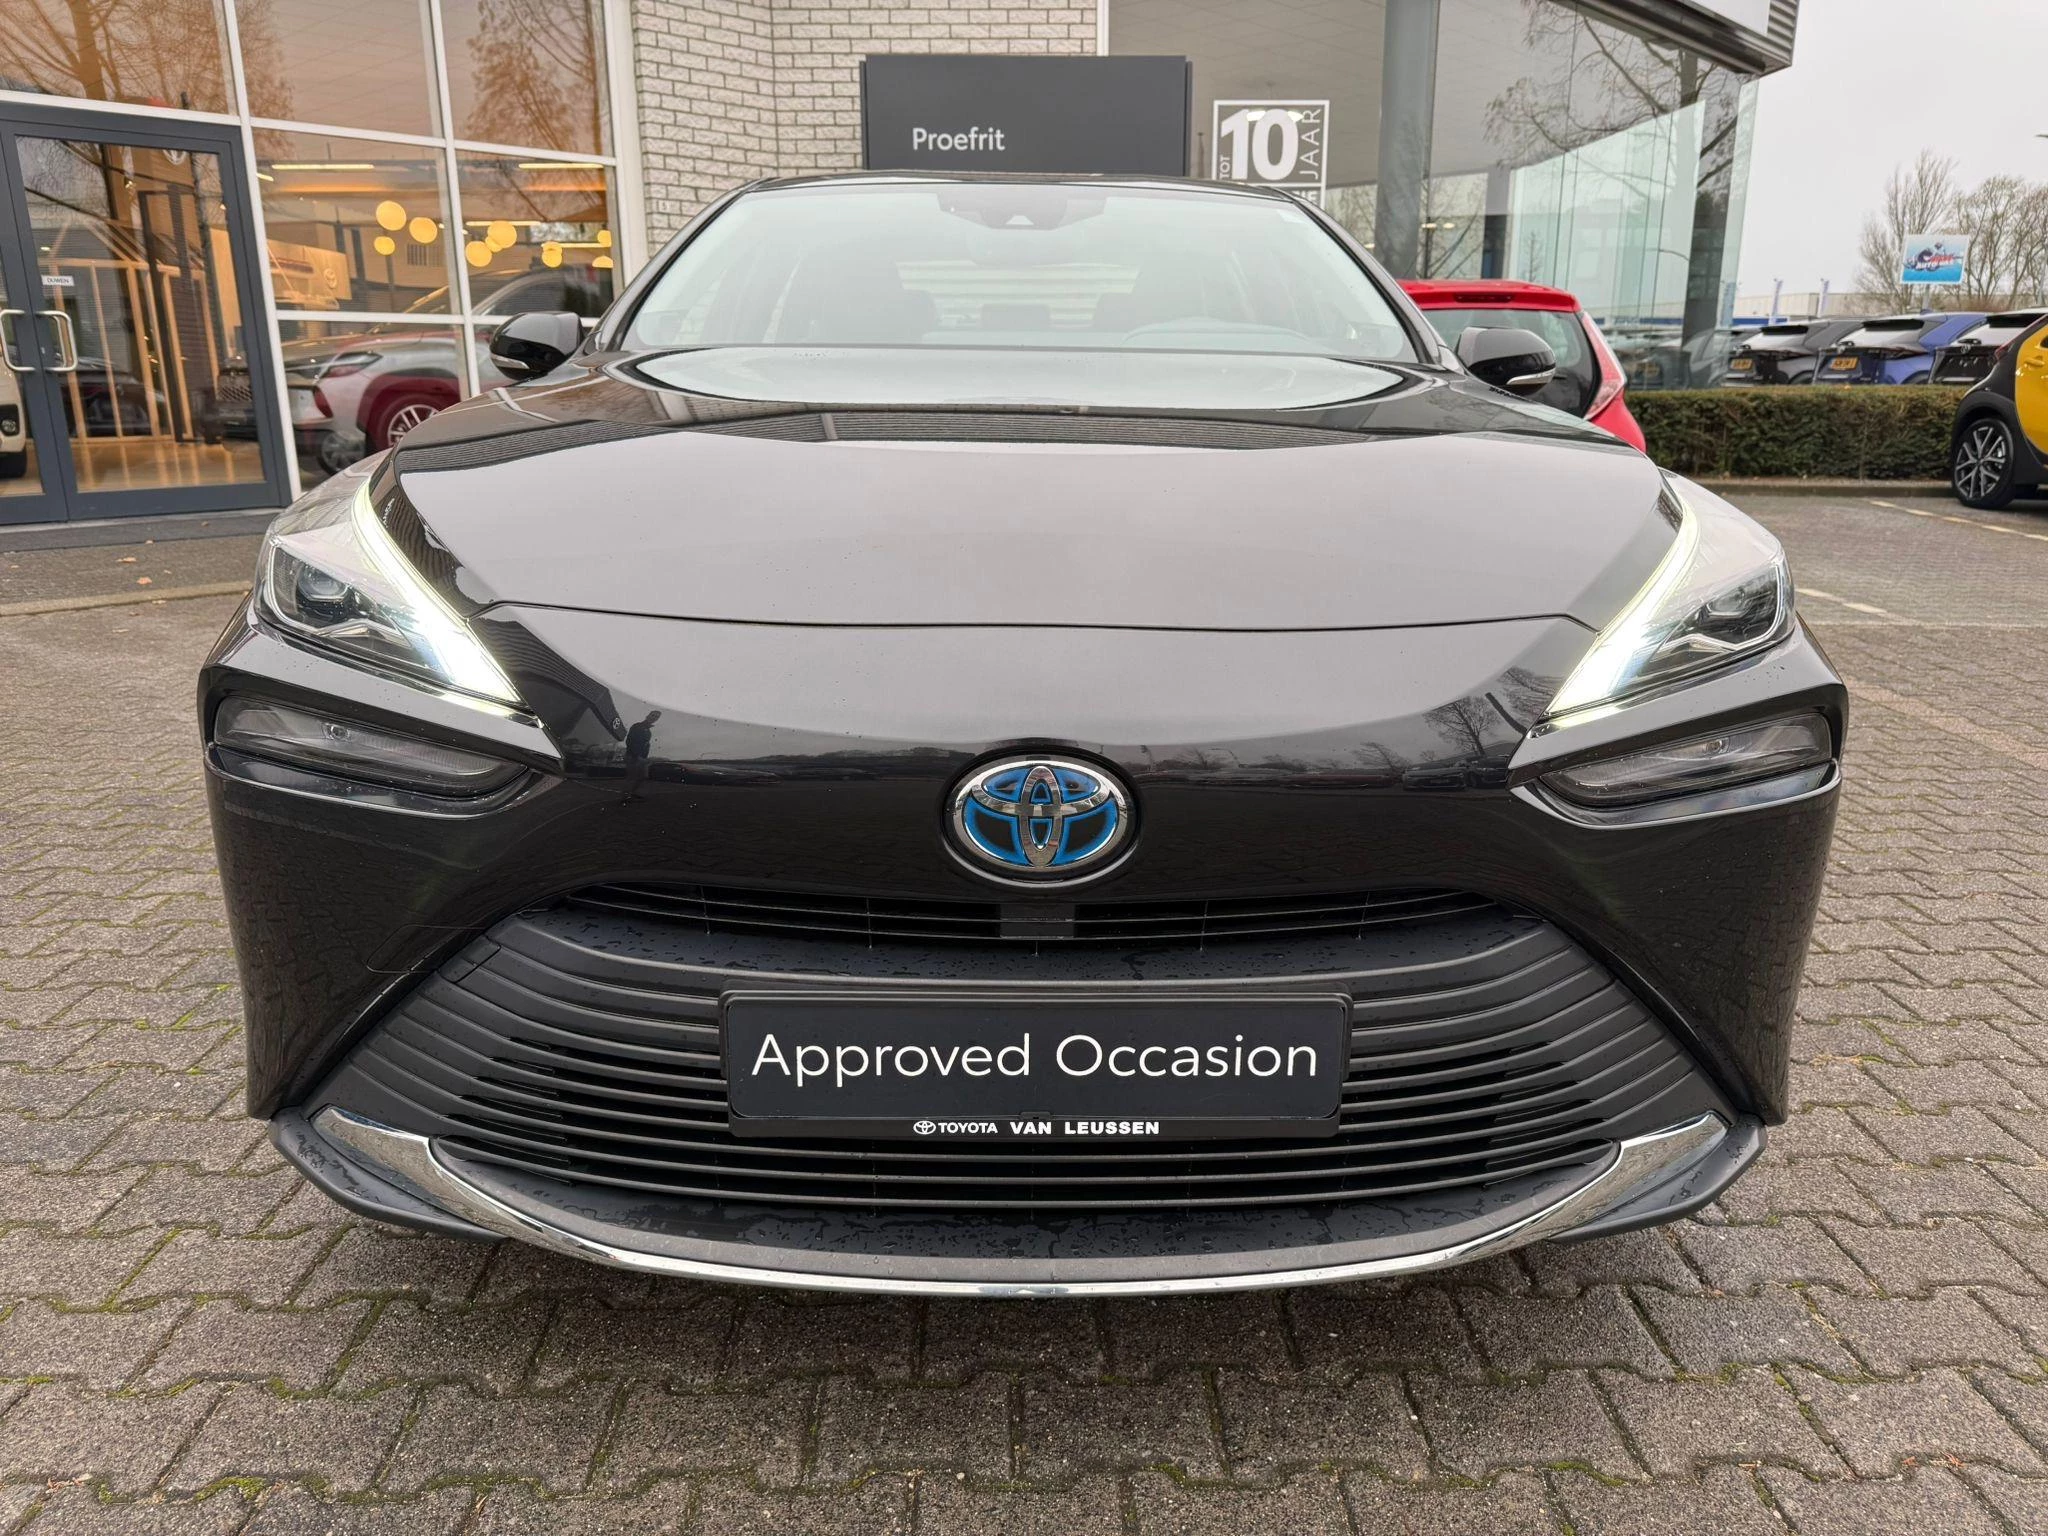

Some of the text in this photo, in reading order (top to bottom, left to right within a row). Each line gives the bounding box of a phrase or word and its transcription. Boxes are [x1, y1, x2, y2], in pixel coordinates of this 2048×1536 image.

[912, 126, 1006, 151] Proefrit
[1220, 108, 1299, 181] 10
[1299, 108, 1322, 180] JAAR
[1219, 154, 1231, 179] TOT
[751, 1032, 1317, 1088] Approved Occasion
[937, 1121, 1160, 1135] TOYOTA VAN LEUSSEN
